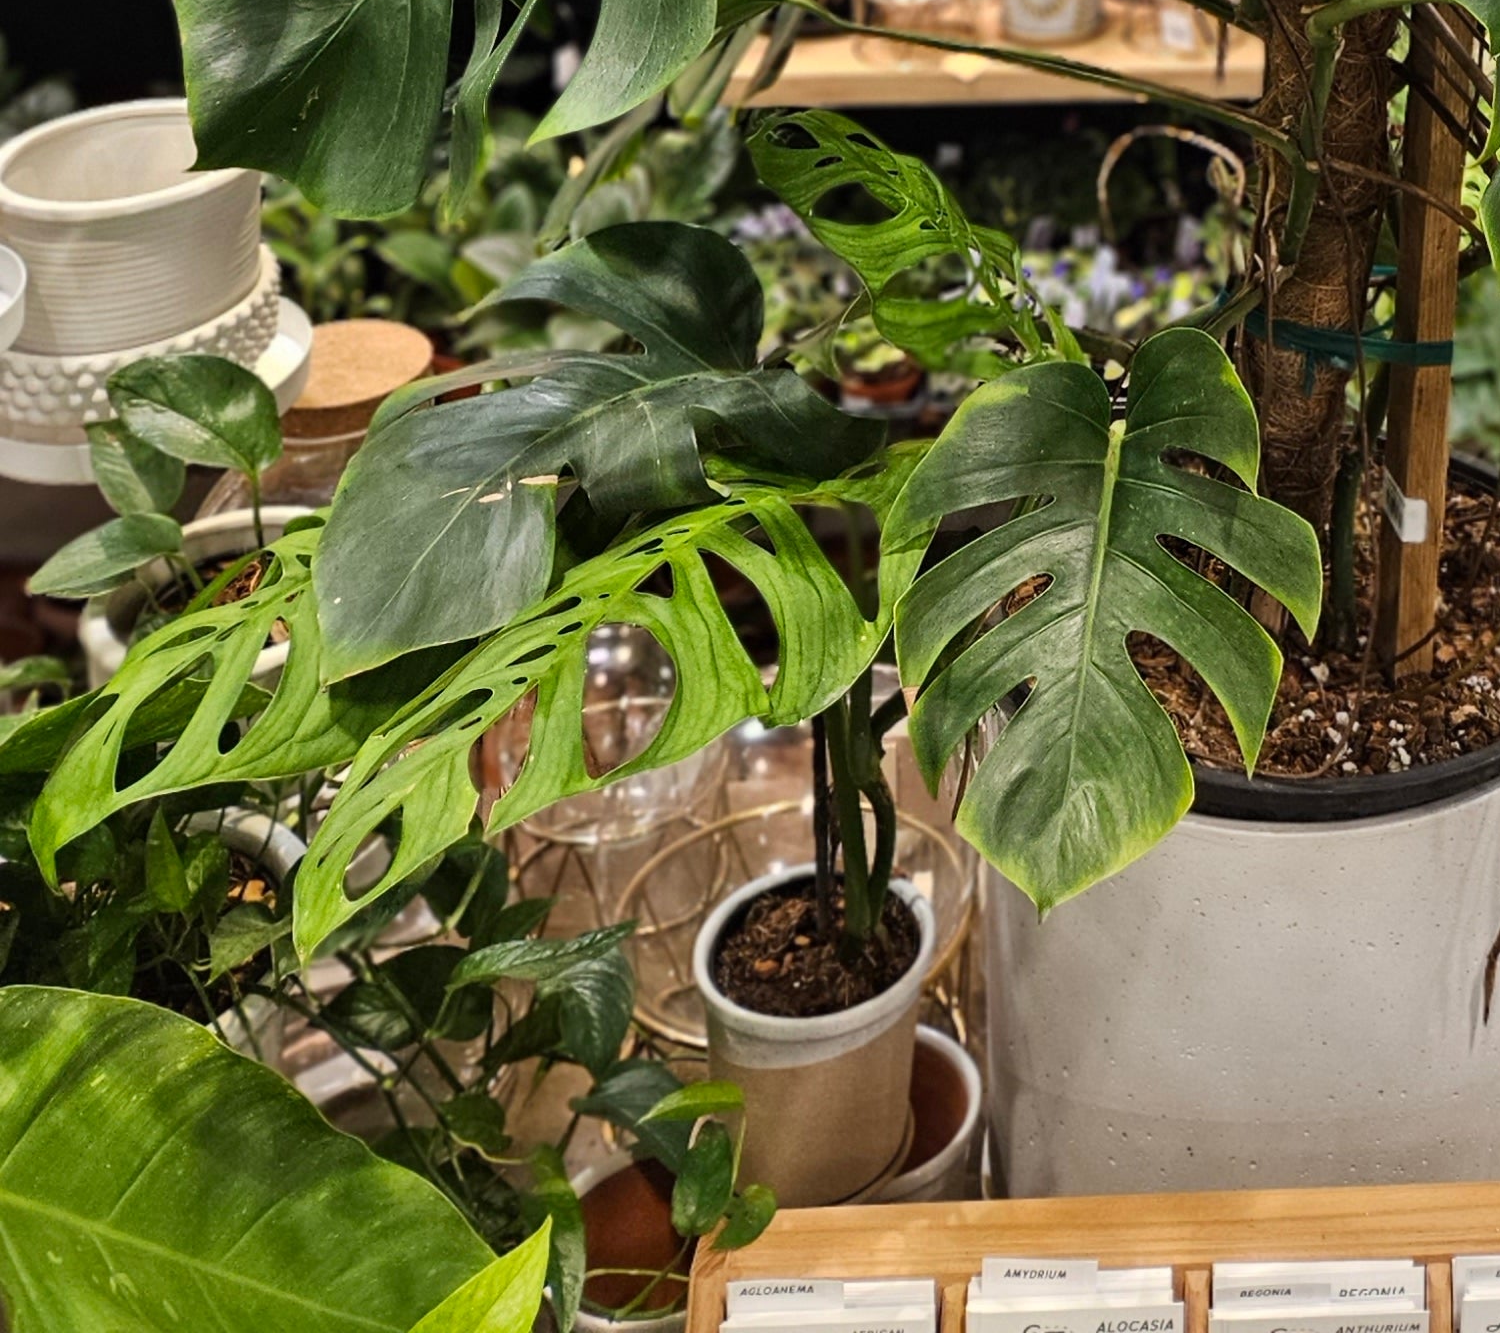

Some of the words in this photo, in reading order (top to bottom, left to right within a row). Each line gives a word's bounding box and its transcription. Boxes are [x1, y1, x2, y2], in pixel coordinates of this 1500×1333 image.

[1004, 1269, 1067, 1279] AMYDRIUM
[1240, 1288, 1292, 1298] BEGONIA
[1096, 1318, 1174, 1333] ALOCASIA
[1335, 1323, 1420, 1333] ANTHURIUM
